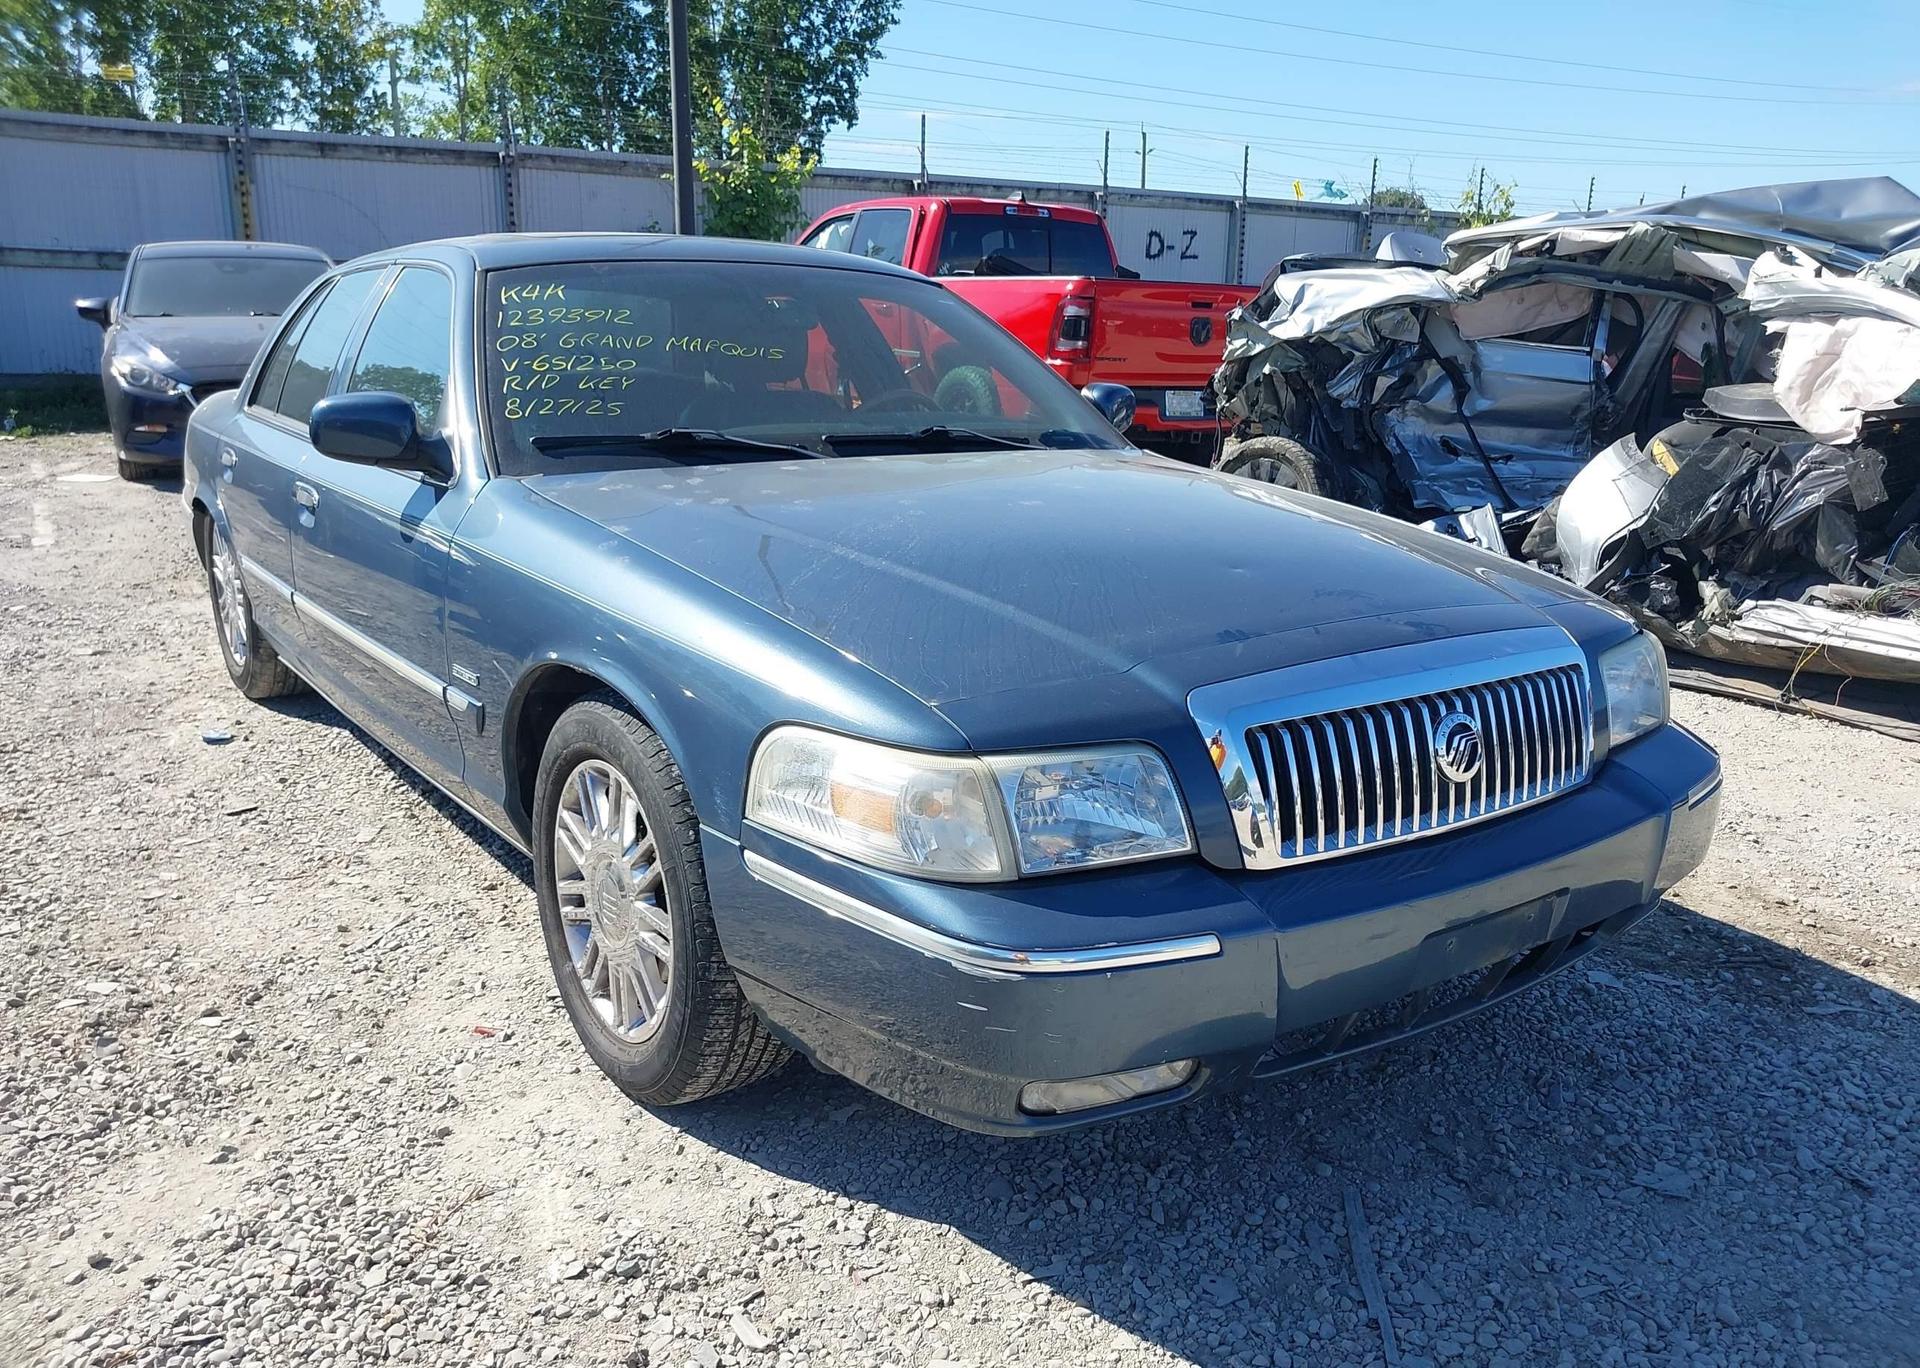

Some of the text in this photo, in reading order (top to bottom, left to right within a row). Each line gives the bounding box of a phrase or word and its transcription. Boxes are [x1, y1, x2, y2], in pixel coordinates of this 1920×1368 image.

[1145, 229, 1199, 260] D-Z
[500, 283, 566, 305] K4K
[497, 307, 634, 328] 12393912
[559, 332, 653, 350] GRAND
[503, 374, 636, 394] R/D KEY
[504, 397, 625, 419] 8/27/25
